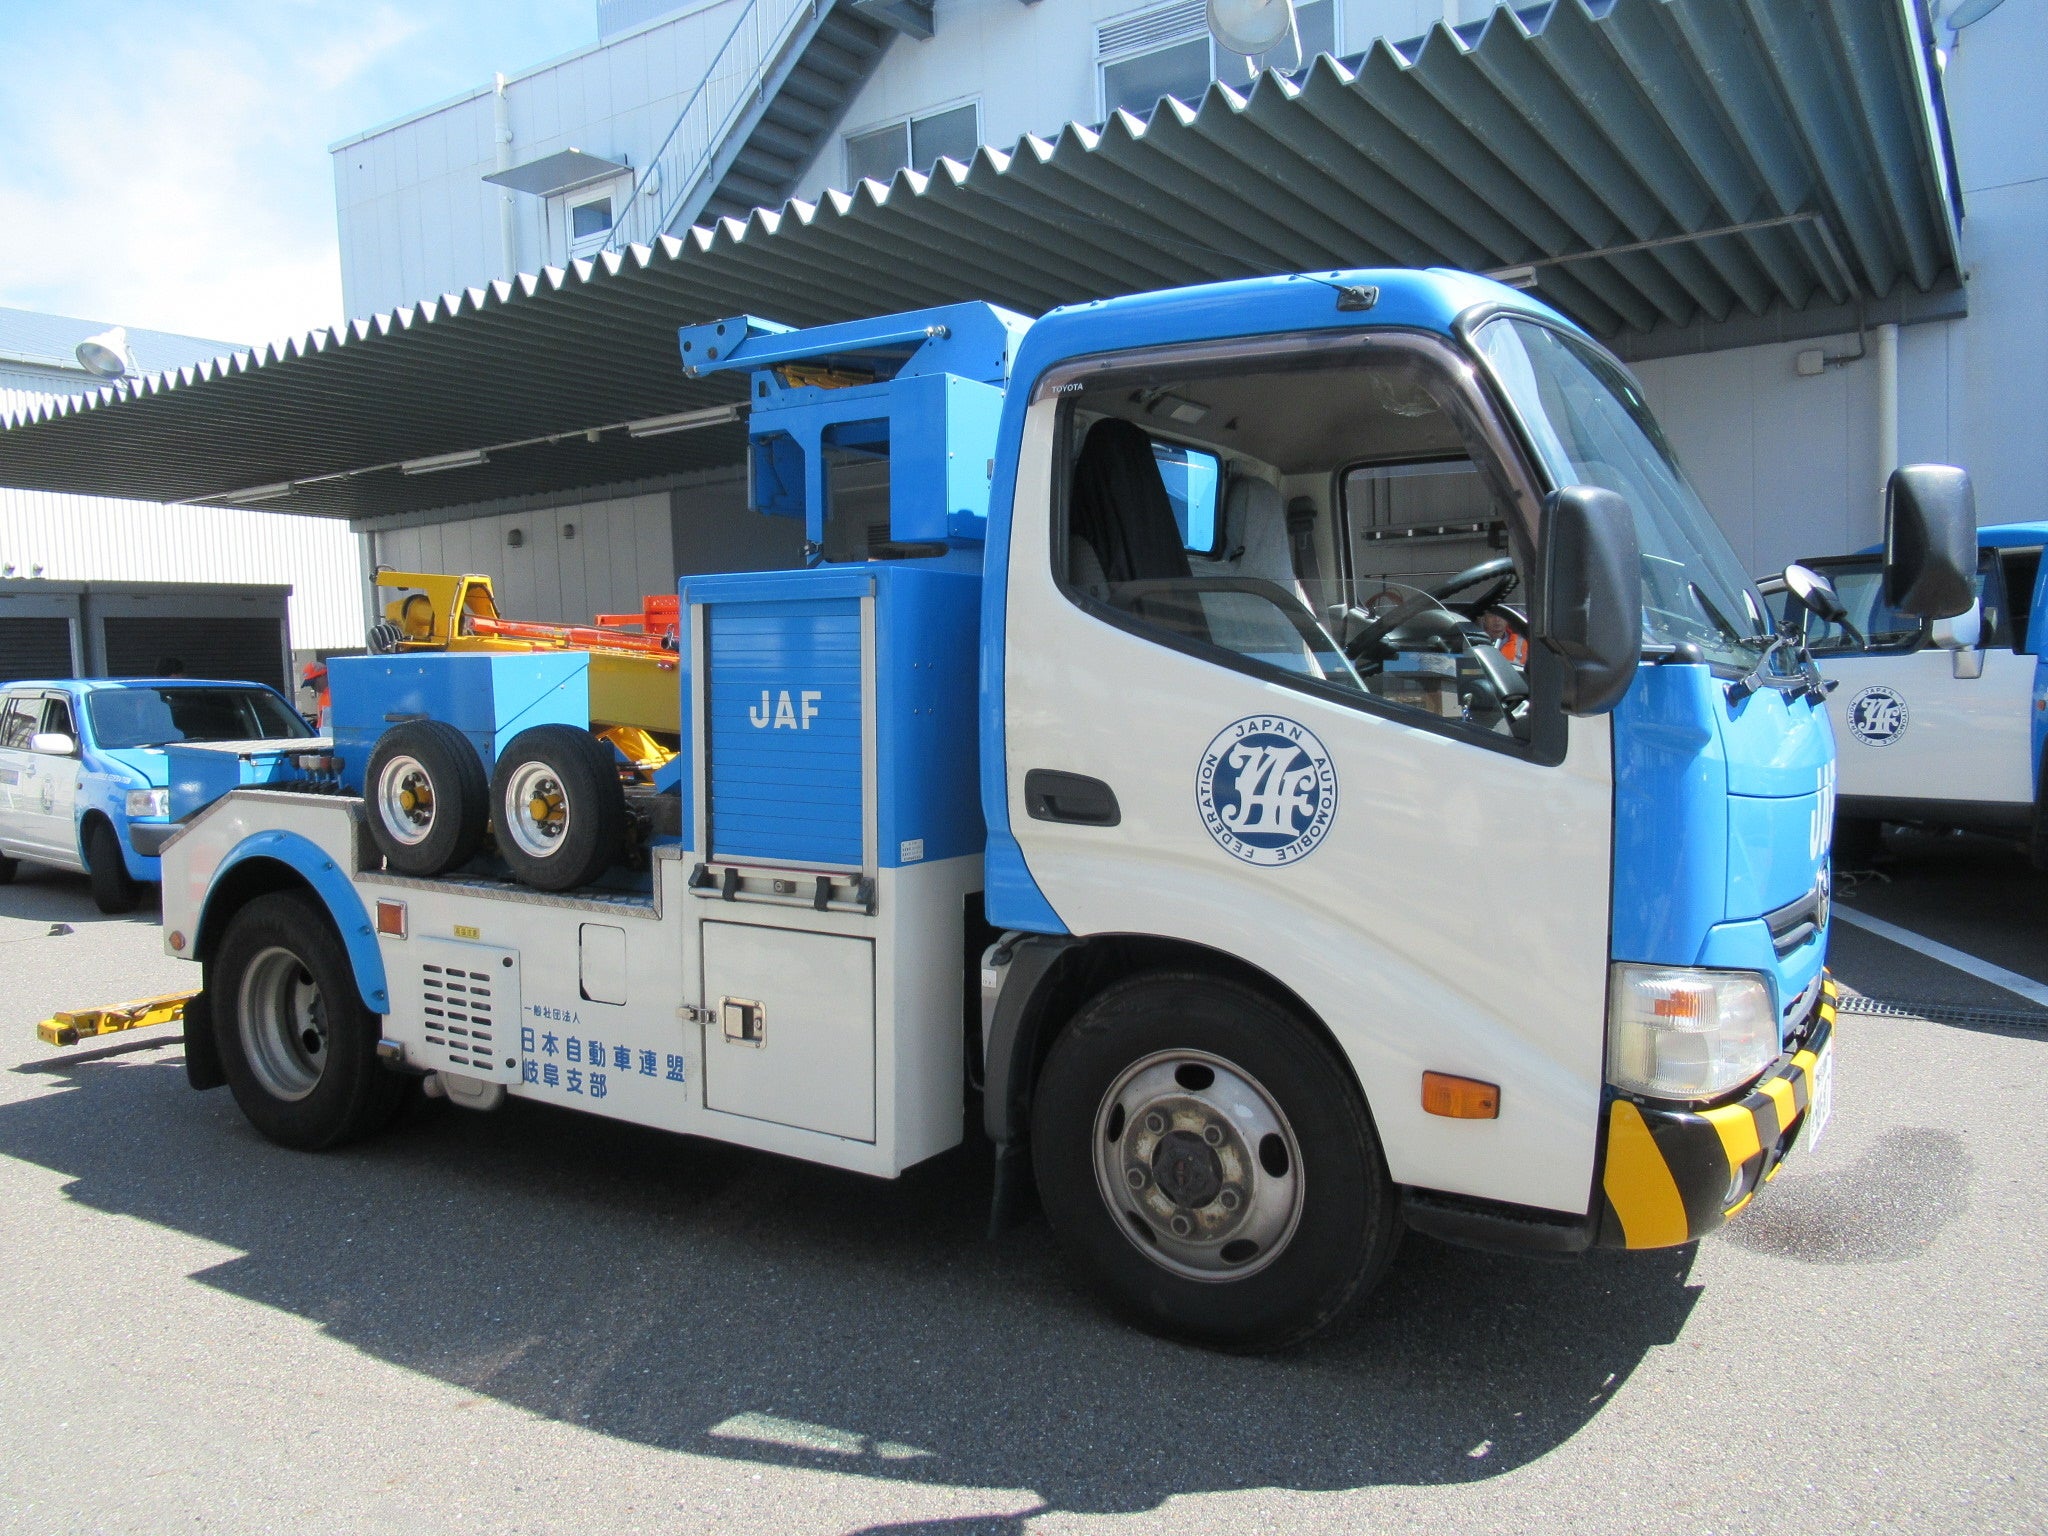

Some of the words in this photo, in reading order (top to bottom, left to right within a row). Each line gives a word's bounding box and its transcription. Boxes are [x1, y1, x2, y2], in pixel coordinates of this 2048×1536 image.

[1052, 383, 1084, 393] TOYOTA
[749, 690, 822, 730] JAF
[1235, 719, 1303, 741] JAPAN
[1200, 753, 1255, 859] FEDERATION
[1275, 756, 1333, 861] AUTOMOBILE
[524, 1004, 581, 1025] 一般社団法人
[521, 1026, 685, 1082] 日本自動車連盟
[522, 1058, 608, 1099] 岐阜支部
